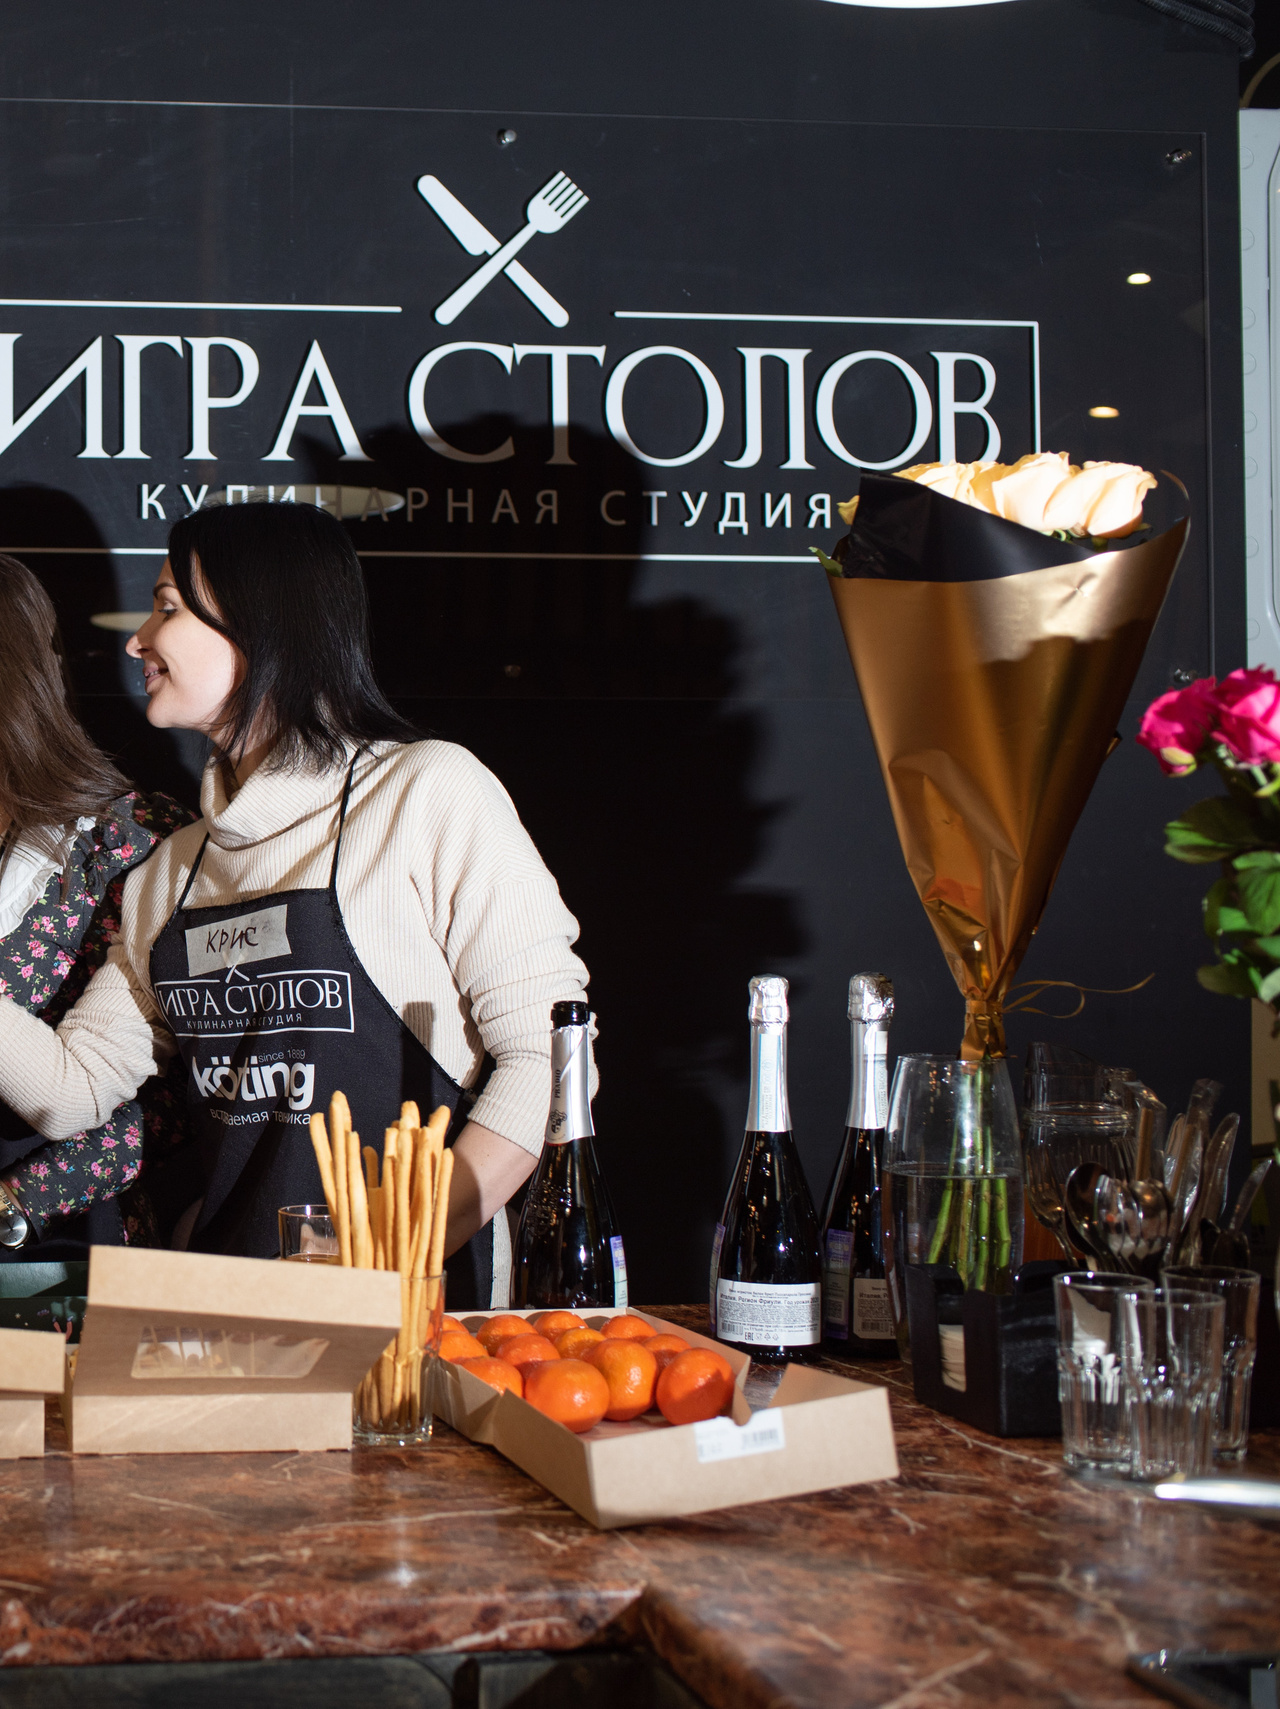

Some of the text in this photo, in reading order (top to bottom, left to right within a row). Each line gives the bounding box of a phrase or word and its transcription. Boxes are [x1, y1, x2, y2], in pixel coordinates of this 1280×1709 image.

[408, 341, 1002, 470] СТОЛОВ
[600, 490, 832, 535] СТУДИЯ
[205, 926, 259, 953] КРИС
[158, 979, 343, 1017] ИГРА СТОЛОВ
[258, 1049, 306, 1063] since 1889
